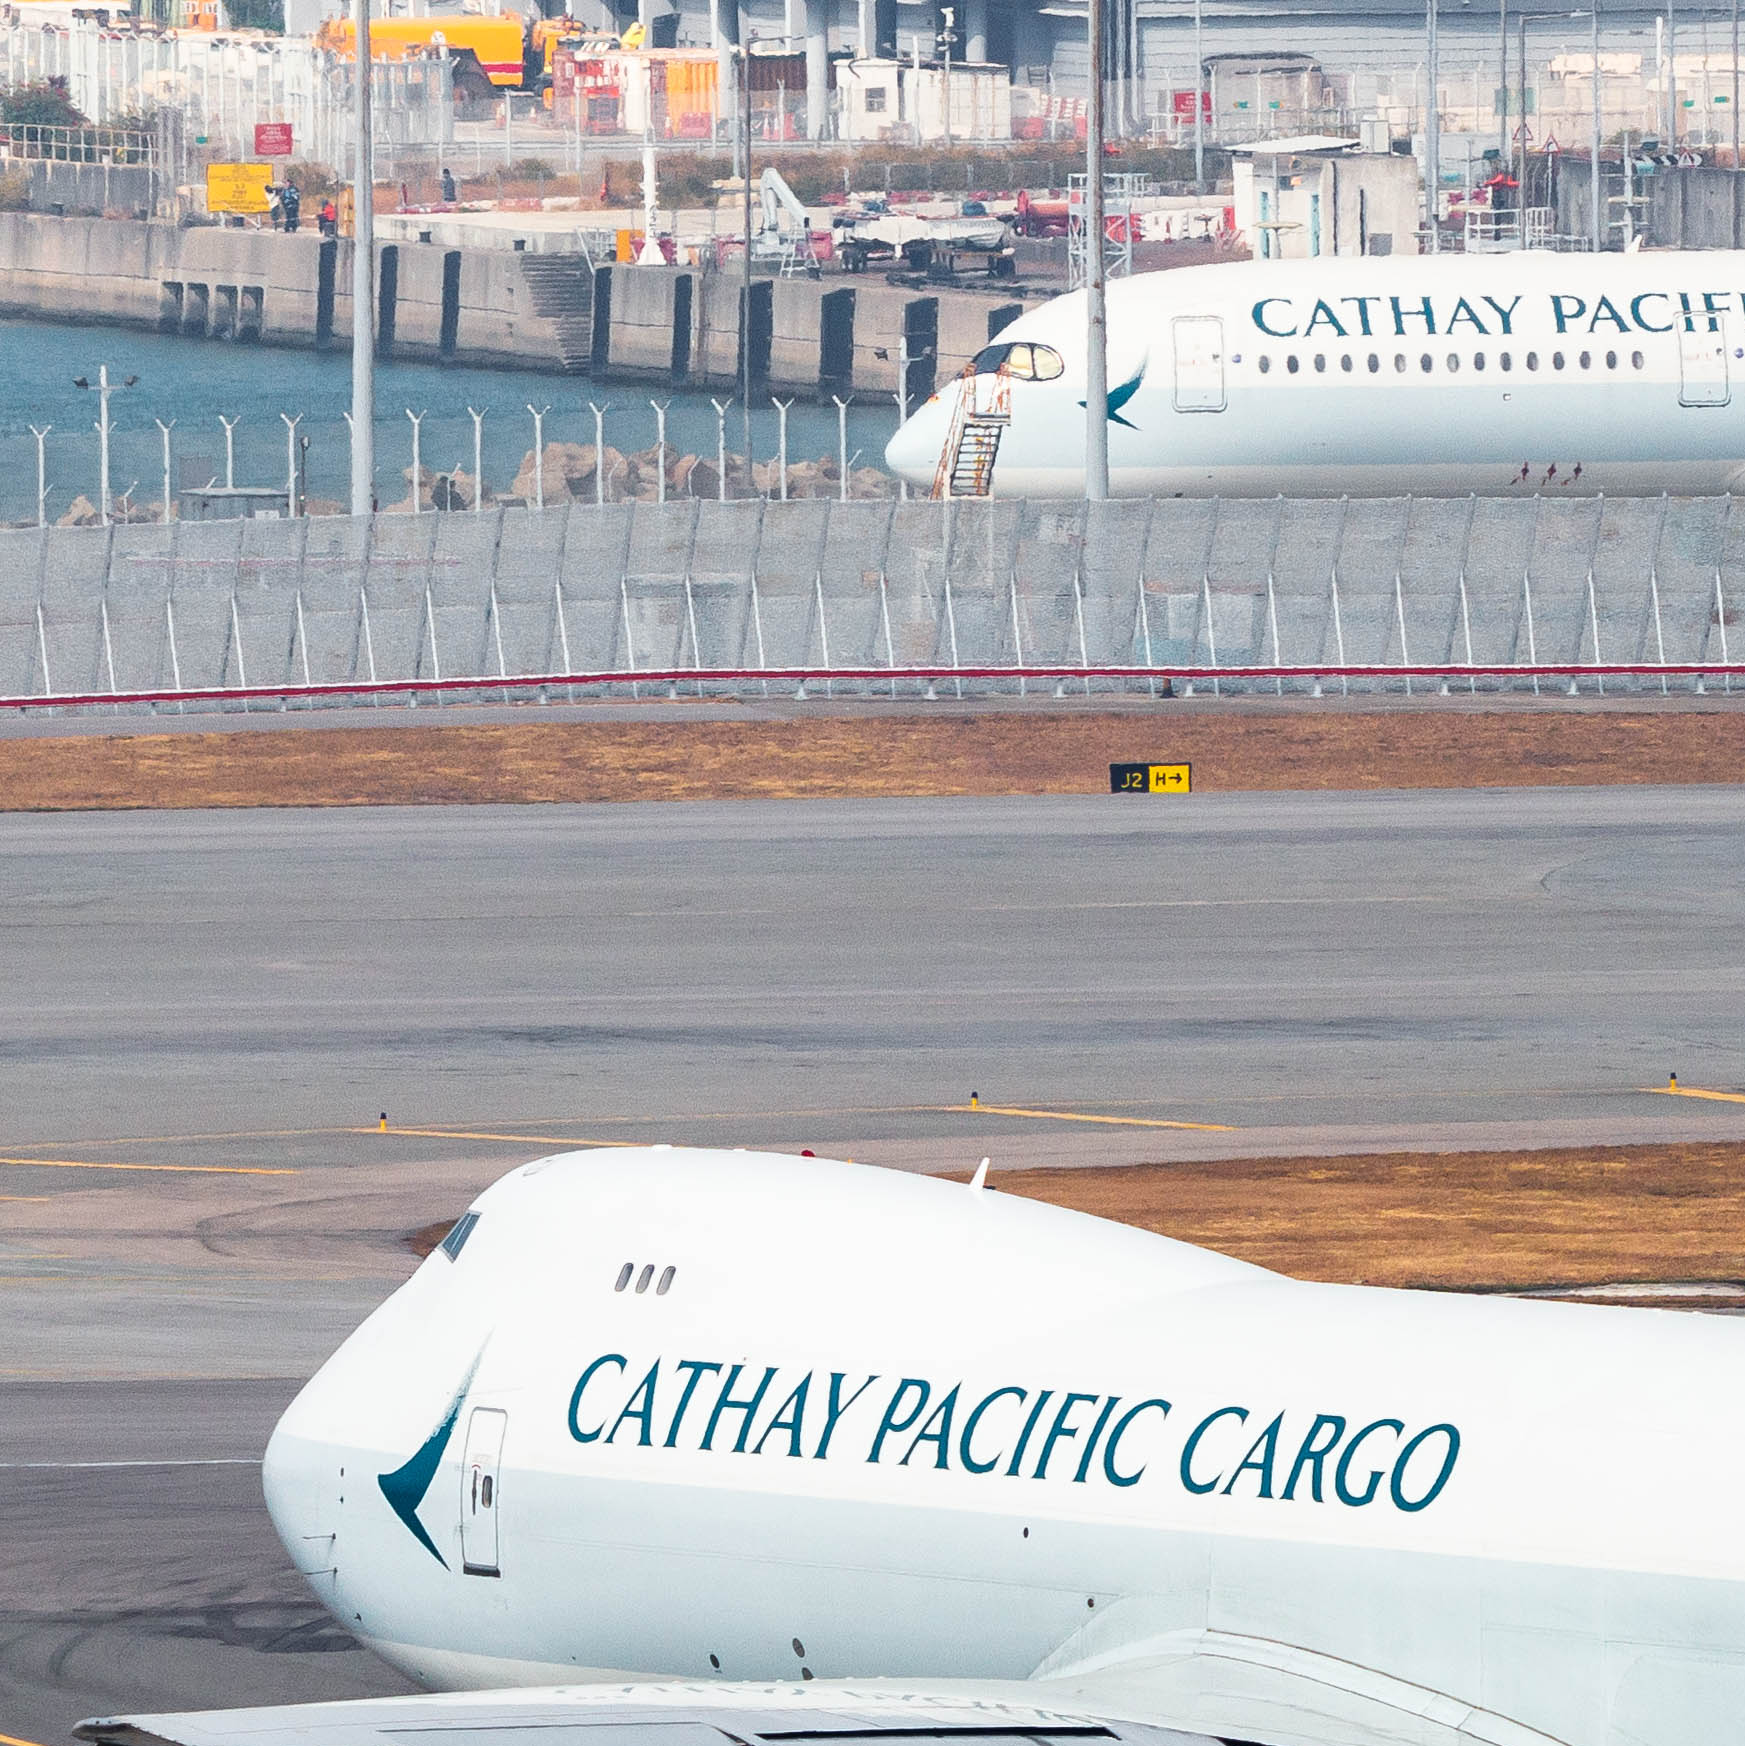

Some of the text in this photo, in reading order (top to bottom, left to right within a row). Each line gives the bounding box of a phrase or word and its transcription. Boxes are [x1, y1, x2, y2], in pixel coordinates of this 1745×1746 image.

[1251, 295, 1523, 337] CATHAY
[1120, 771, 1166, 788] J2 H
[566, 1353, 1462, 1513] CATHAY PACIFIC CARGO
